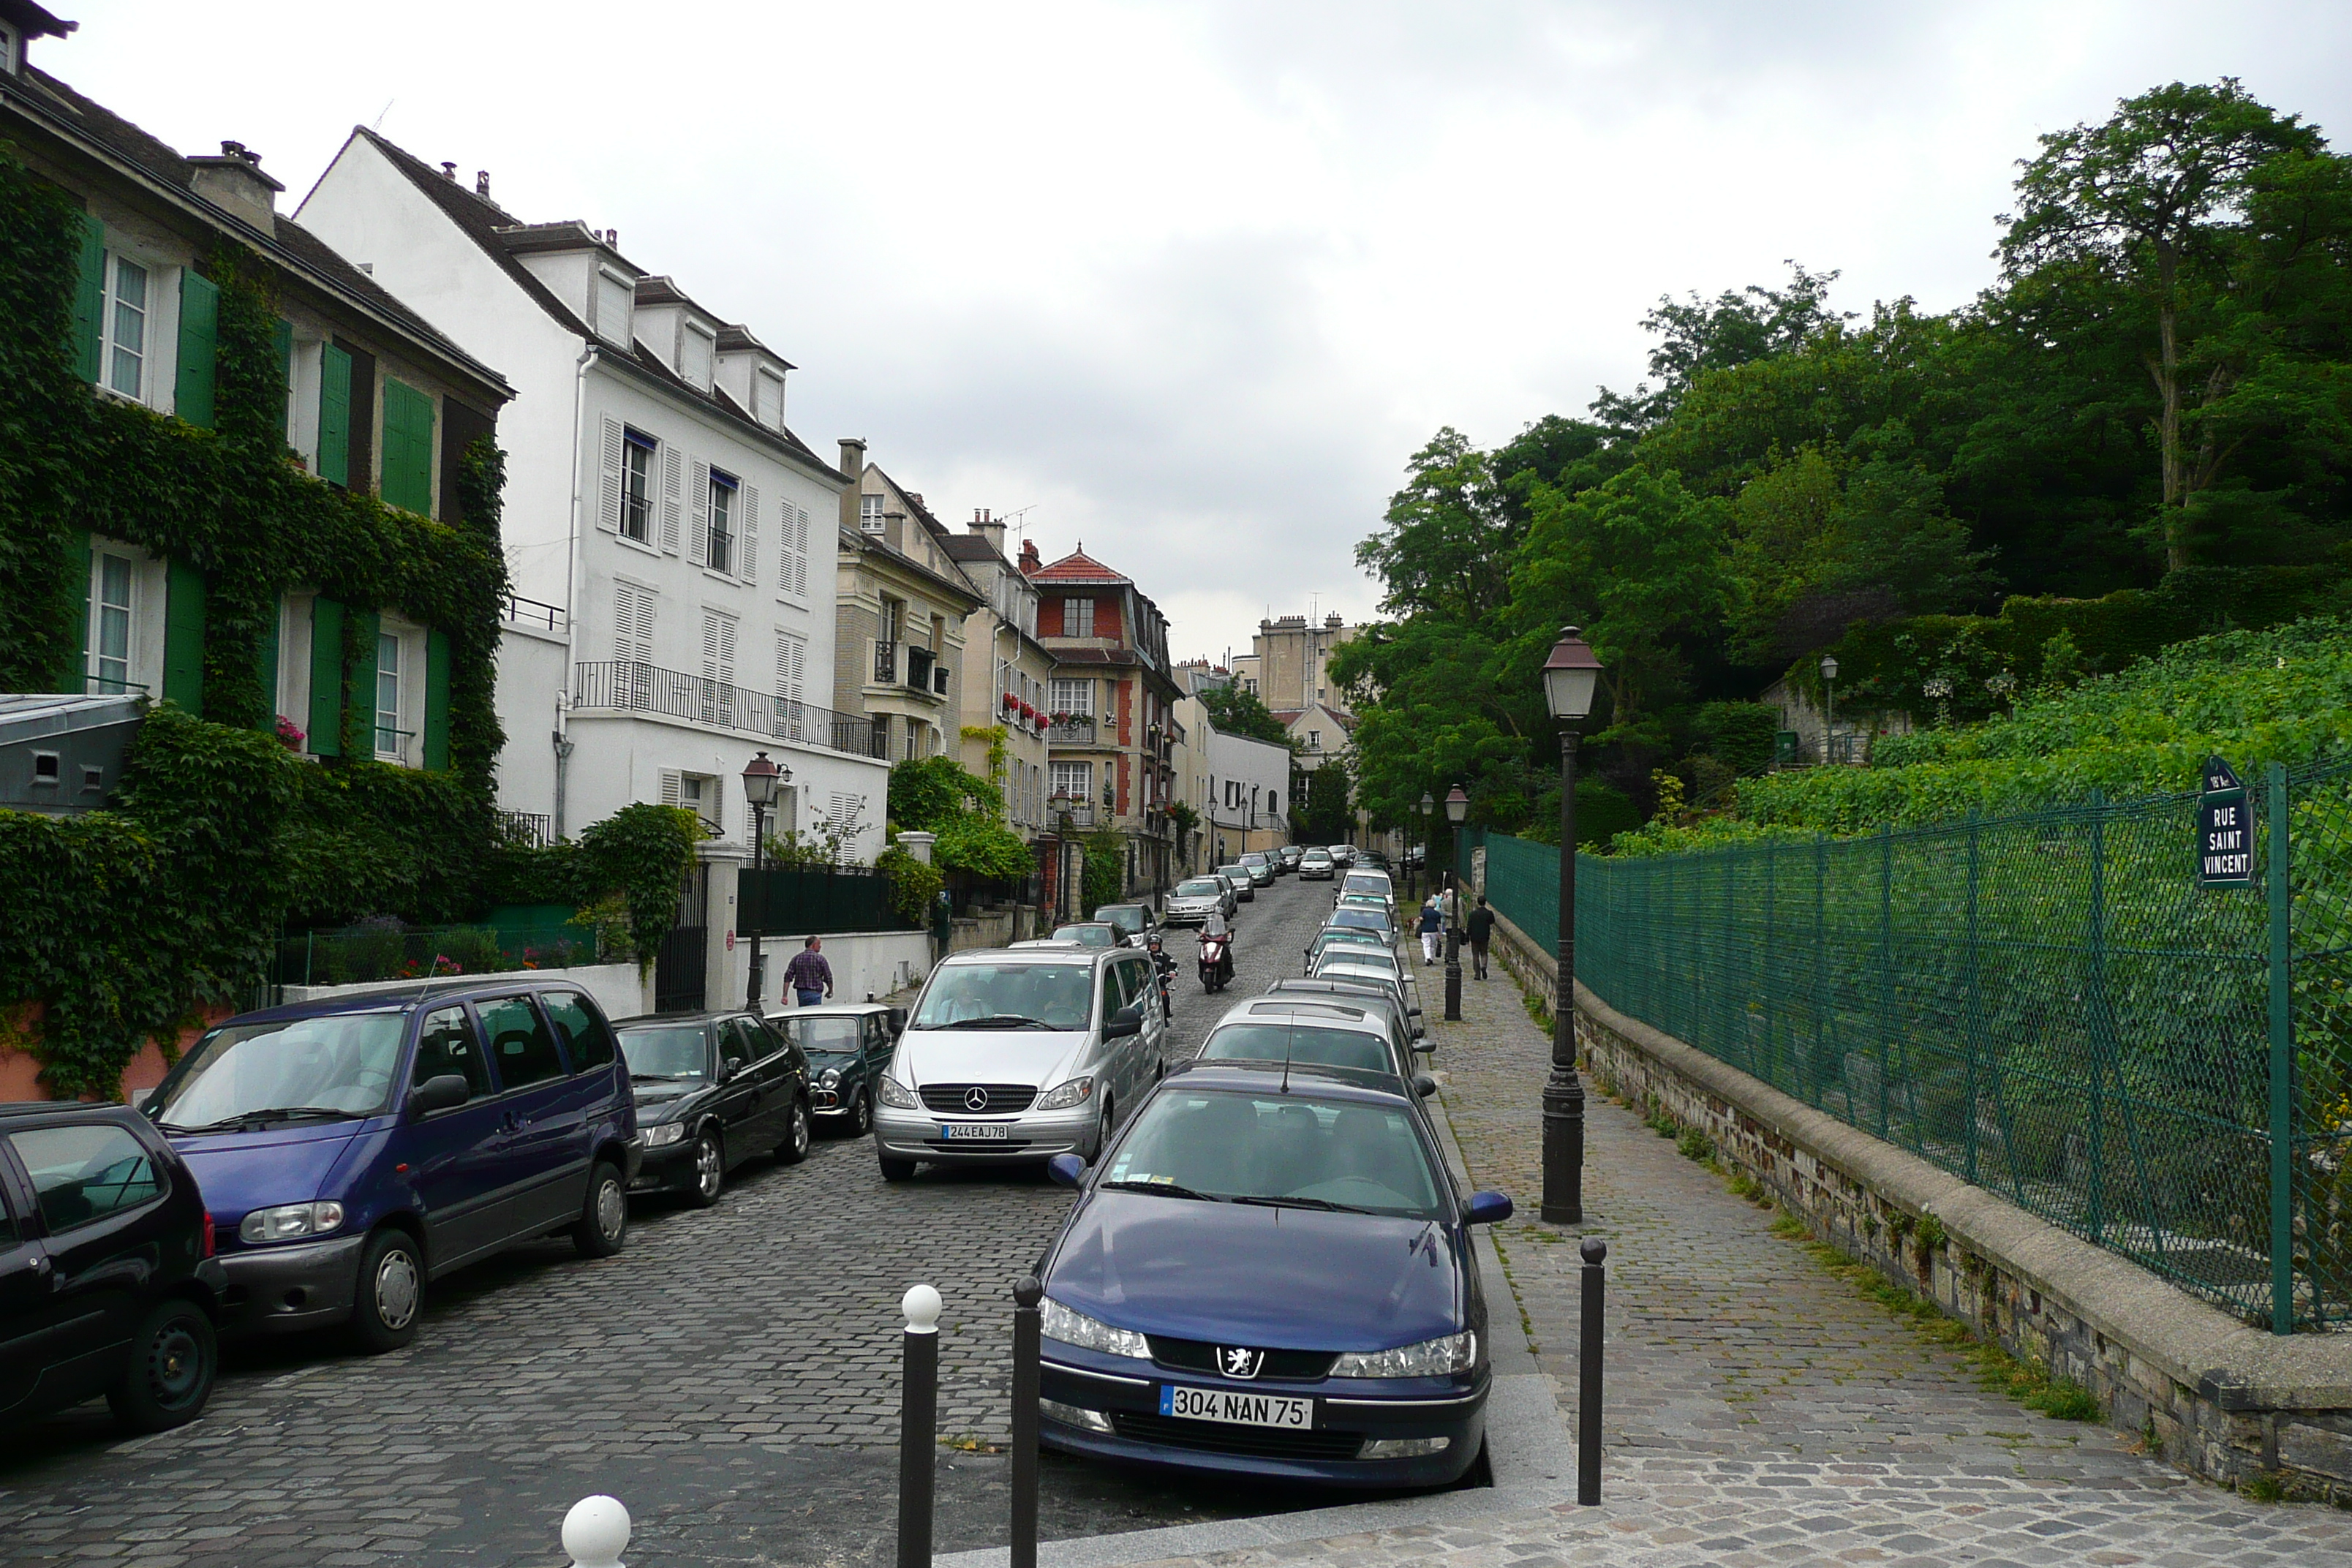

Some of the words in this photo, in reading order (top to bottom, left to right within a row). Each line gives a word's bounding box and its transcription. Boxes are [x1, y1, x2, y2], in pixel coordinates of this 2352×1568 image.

[2214, 807, 2236, 827] RUE
[2209, 830, 2242, 851] SAINT
[2204, 853, 2247, 875] VINCENT
[1175, 1390, 1218, 1417] 304
[1224, 1395, 1269, 1422] NAN
[1275, 1400, 1303, 1425] 75
